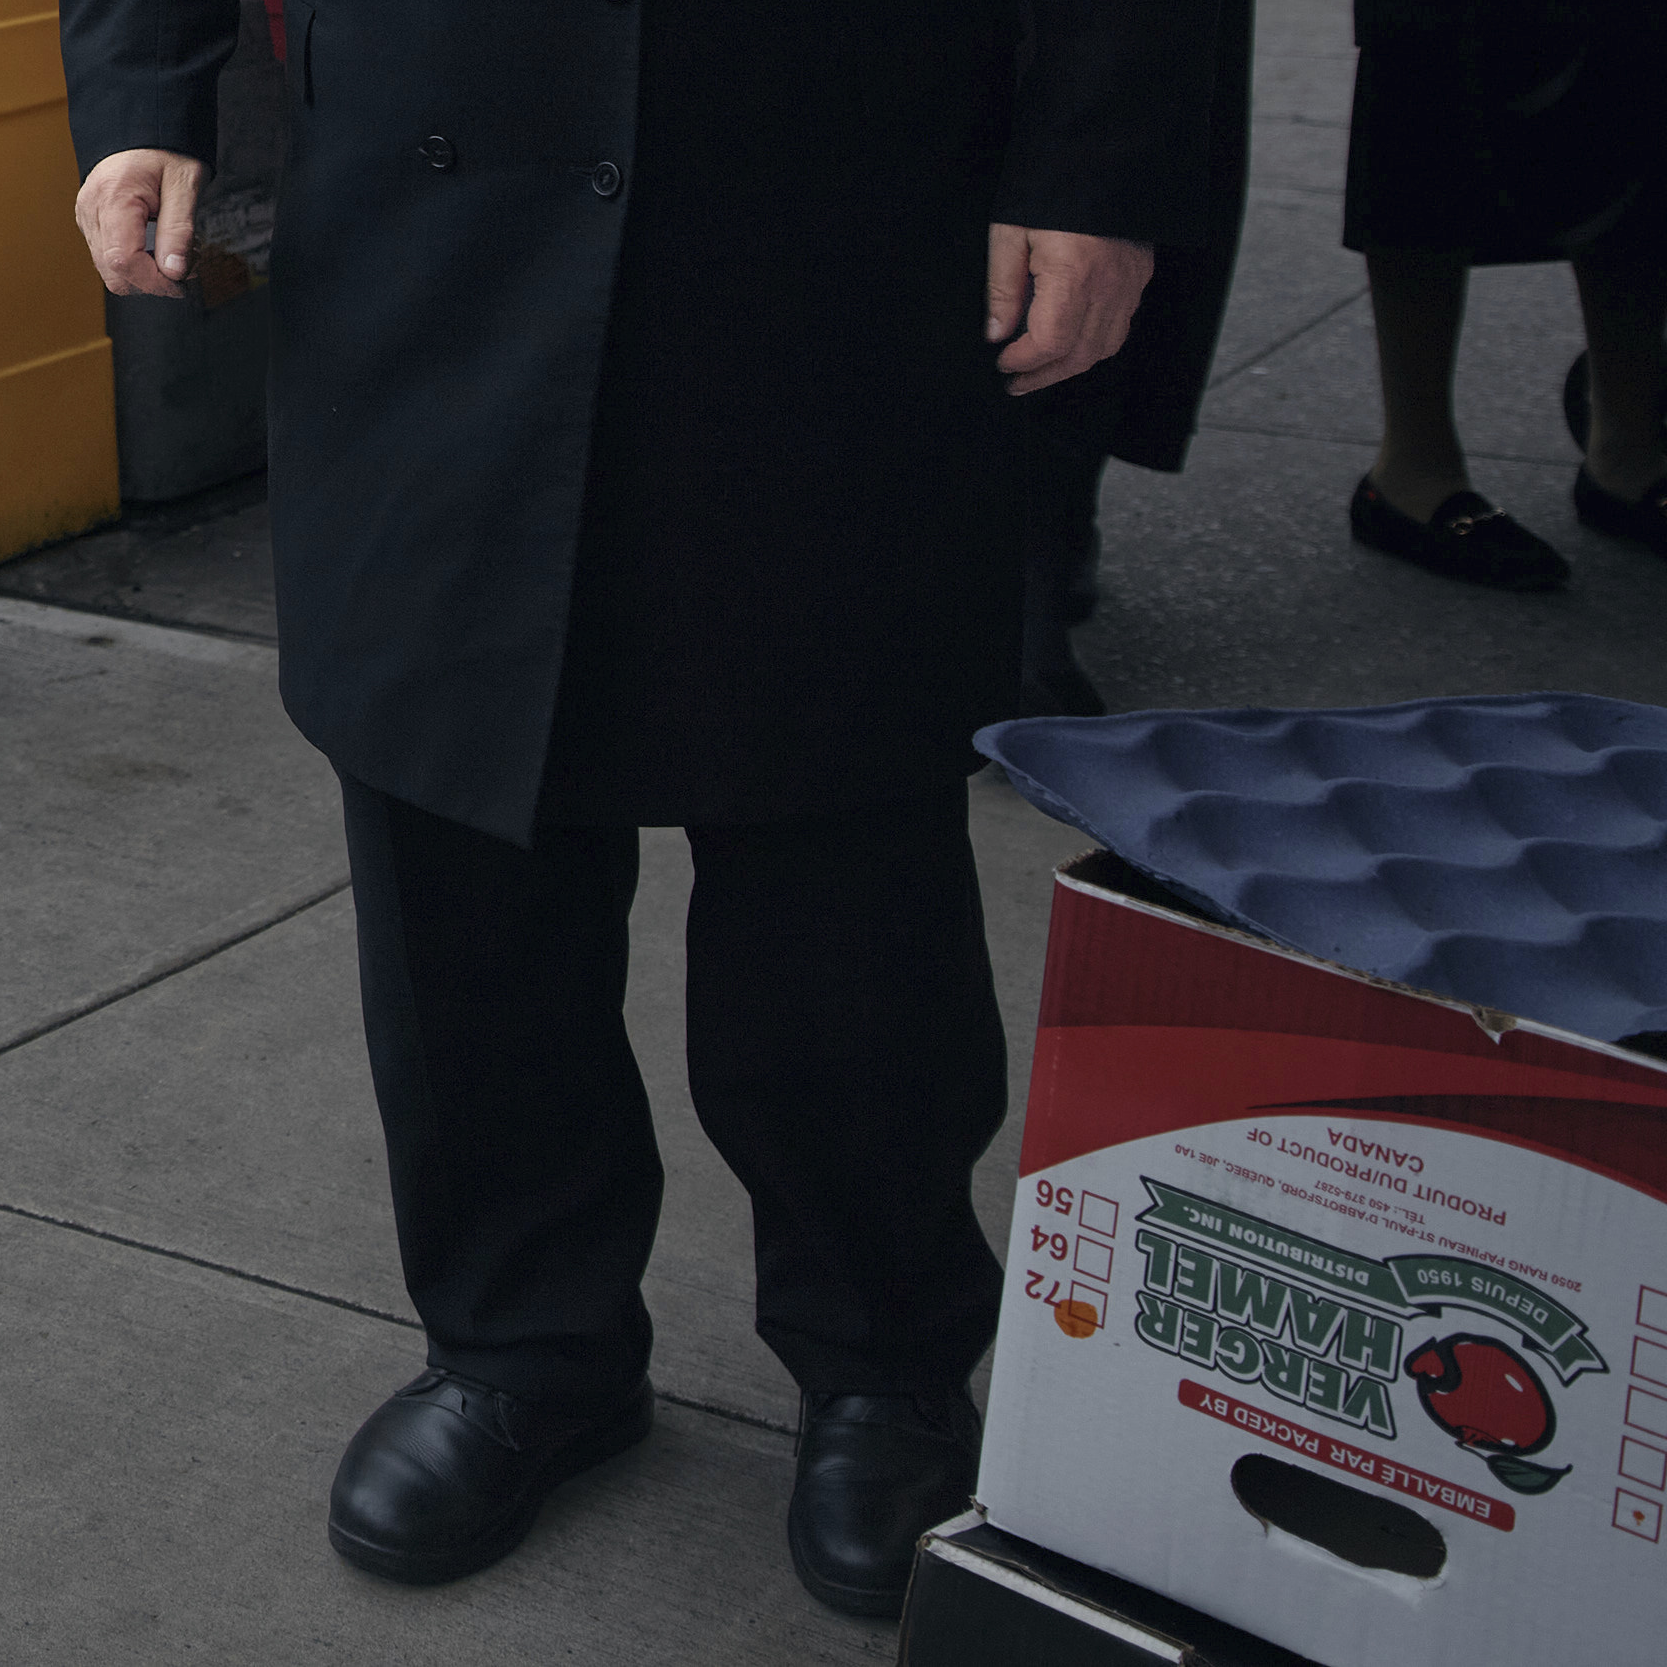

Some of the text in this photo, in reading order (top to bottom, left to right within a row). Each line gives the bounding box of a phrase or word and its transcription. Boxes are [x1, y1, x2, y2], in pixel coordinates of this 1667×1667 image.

[1326, 1127, 1425, 1174] CANADA
[1035, 1179, 1075, 1216] 56
[1246, 1127, 1507, 1227] PRODUIT DU/PRODUCT OF
[1279, 1180, 1380, 1225] D'ABBOTSFORD,
[1369, 1197, 1392, 1213] 450
[1030, 1224, 1069, 1262] 64
[1182, 1205, 1369, 1287] DISTRIBUTION INC.
[1382, 1217, 1435, 1246] ST-PAUL
[1438, 1236, 1506, 1267] PAPINEAU
[1024, 1268, 1062, 1309] 72
[1508, 1260, 1548, 1281] RANG
[1551, 1273, 1583, 1293] 2050
[1135, 1228, 1403, 1383] HAMEL
[1416, 1268, 1550, 1325] DEPUIS 1950
[1135, 1290, 1398, 1441] VERGER
[1199, 1393, 1492, 1519] EMBALLÉ PAR PACKED BY
